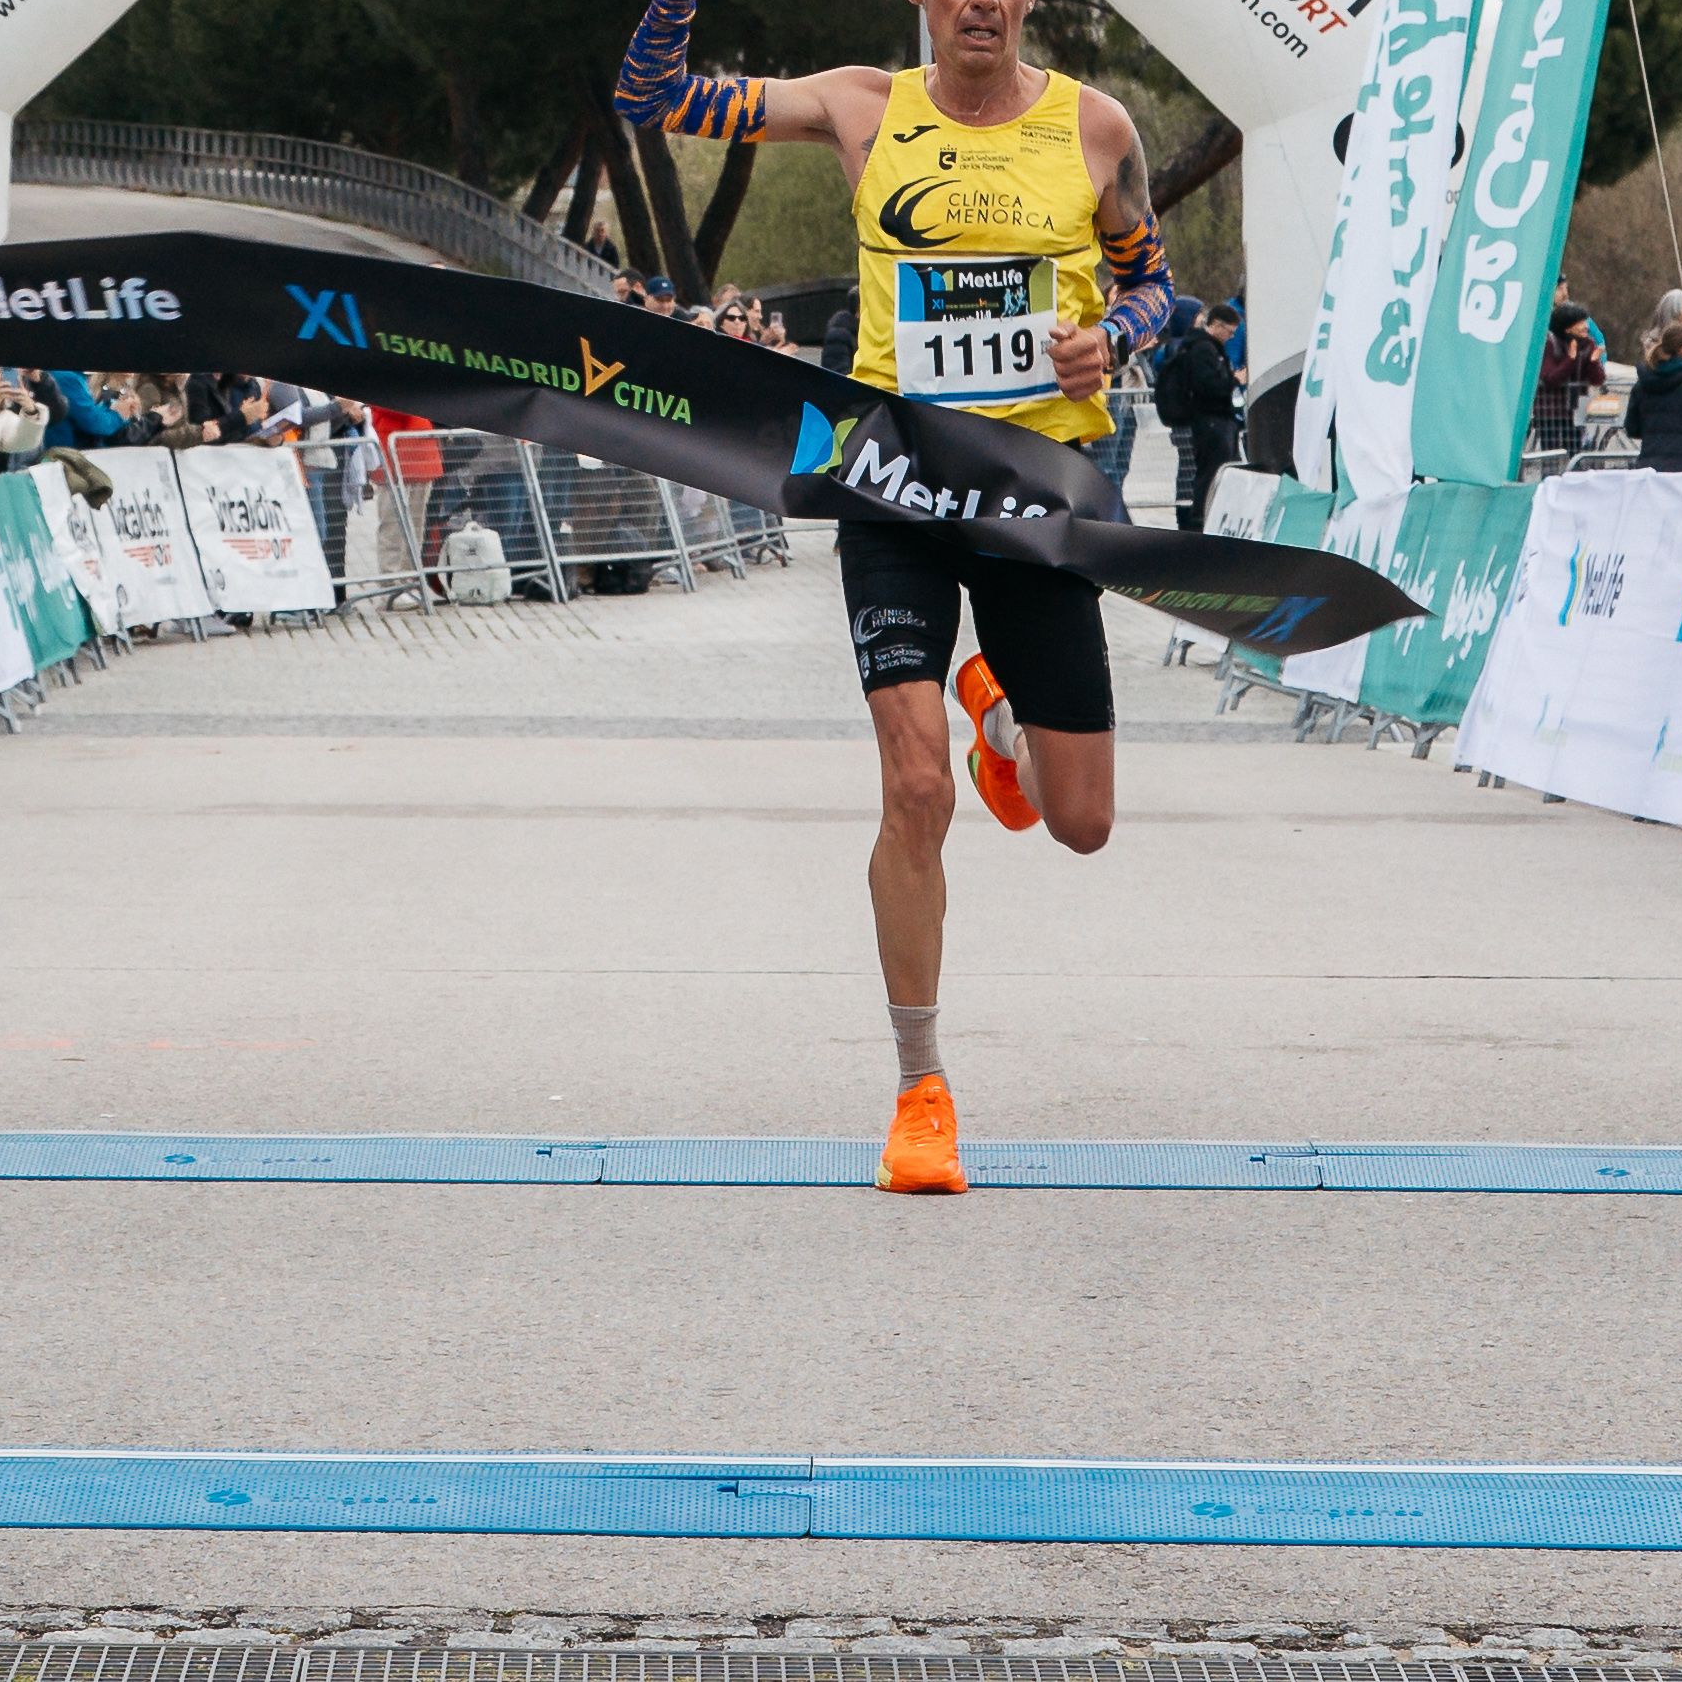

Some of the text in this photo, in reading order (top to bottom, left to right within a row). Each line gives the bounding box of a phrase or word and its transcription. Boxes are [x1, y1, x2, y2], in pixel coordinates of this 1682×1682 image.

[948, 190, 1024, 209] CLÍNICA
[946, 209, 1055, 232] MENORCA
[958, 269, 1023, 288] MetLife
[285, 284, 369, 350] XI
[374, 331, 455, 365] 15KM
[463, 348, 580, 392] MADRID
[924, 328, 1035, 378] 1119
